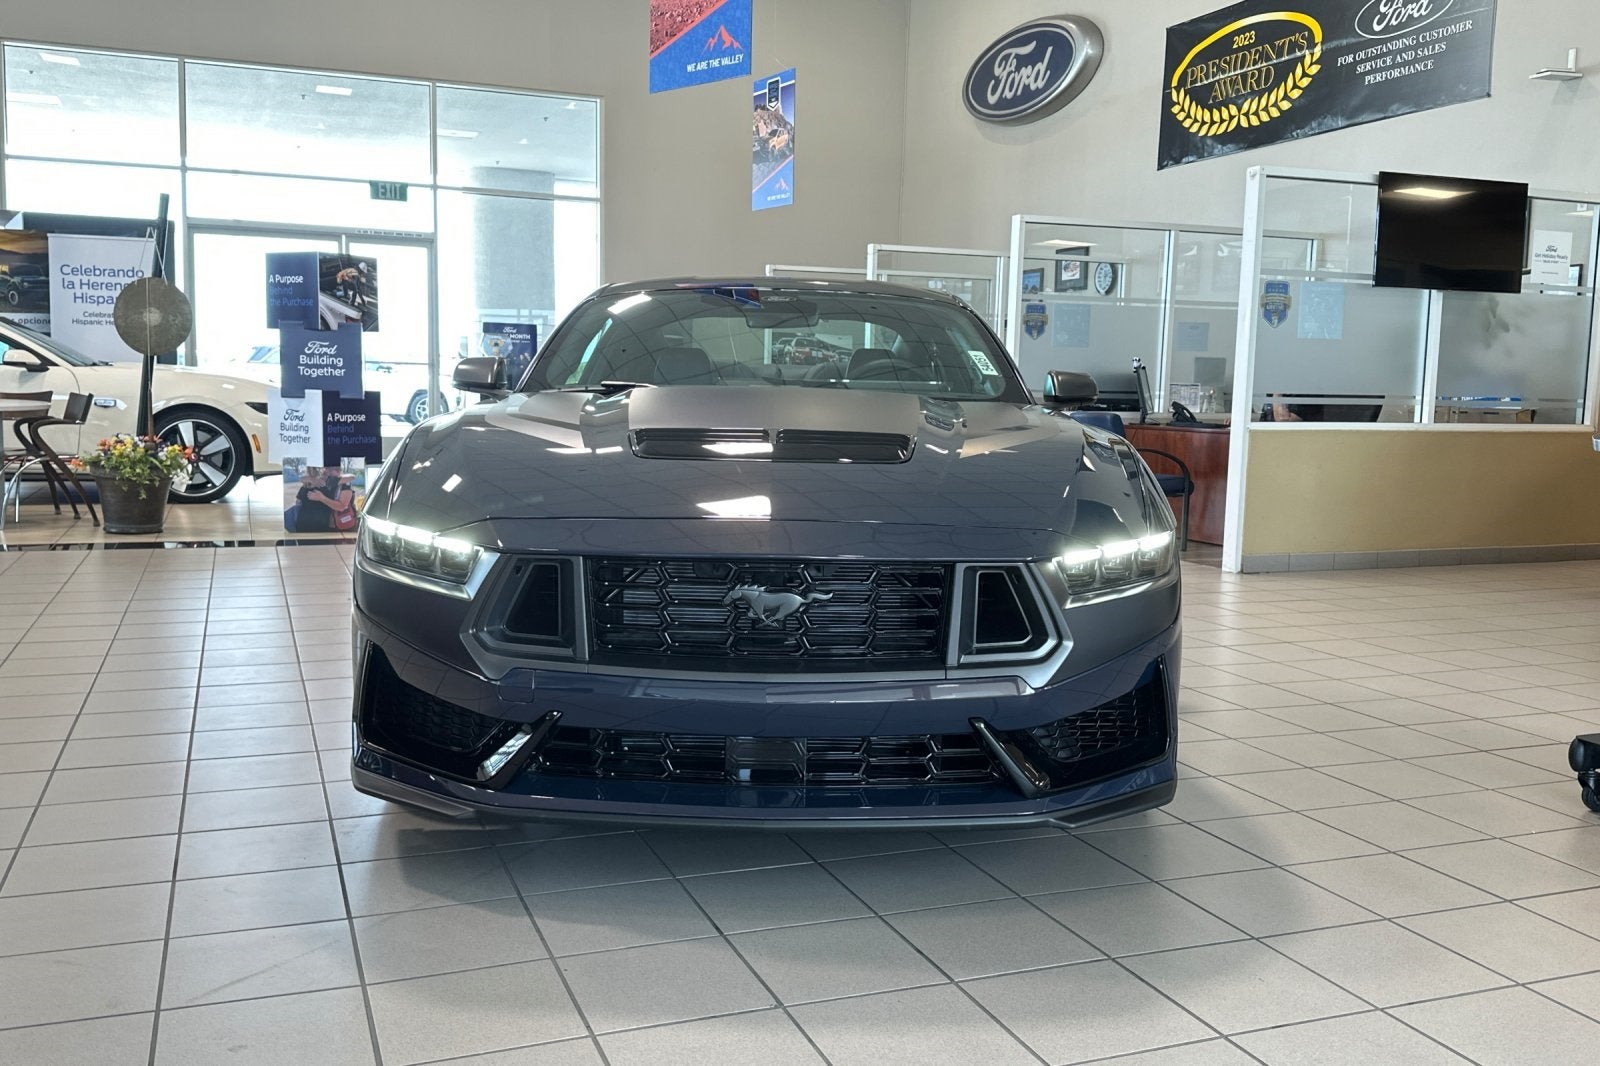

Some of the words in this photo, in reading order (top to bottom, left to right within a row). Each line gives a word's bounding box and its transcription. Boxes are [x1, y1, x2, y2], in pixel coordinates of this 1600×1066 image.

[1372, 0, 1434, 32] Ford
[1232, 30, 1256, 49] 2023
[1337, 54, 1354, 67] FOR
[1355, 36, 1417, 61] OUTSTANDING
[1419, 20, 1473, 43] CUSTOMER
[686, 62, 696, 73] WE
[696, 60, 709, 71] ARE
[709, 58, 720, 68] THE
[721, 53, 744, 66] VALLEY
[1185, 31, 1308, 89] PRESIDENT'S
[1356, 55, 1393, 74] SERVICE
[1395, 50, 1415, 64] AND
[1416, 41, 1447, 58] SALES
[987, 40, 1053, 104] Ford
[1364, 59, 1434, 85] PERFORMANCE
[1208, 65, 1275, 105] AWARD
[378, 182, 402, 200] EXIT
[60, 264, 145, 279] Celebrando
[62, 278, 75, 290] la
[268, 274, 275, 283] A
[275, 274, 304, 285] Purpose
[73, 292, 115, 306] Hispa
[282, 297, 314, 307] Purchase
[18, 316, 50, 326] opcion
[71, 318, 104, 326] Hispanic
[304, 340, 338, 355] Ford
[299, 355, 344, 367] Building
[297, 366, 346, 378] Together
[283, 408, 305, 421] Ford
[327, 413, 333, 422] A
[334, 412, 366, 423] Purpose
[280, 422, 309, 433] Building
[327, 424, 354, 433] Behind
[279, 433, 311, 444] Together
[342, 435, 377, 444] Purchase
